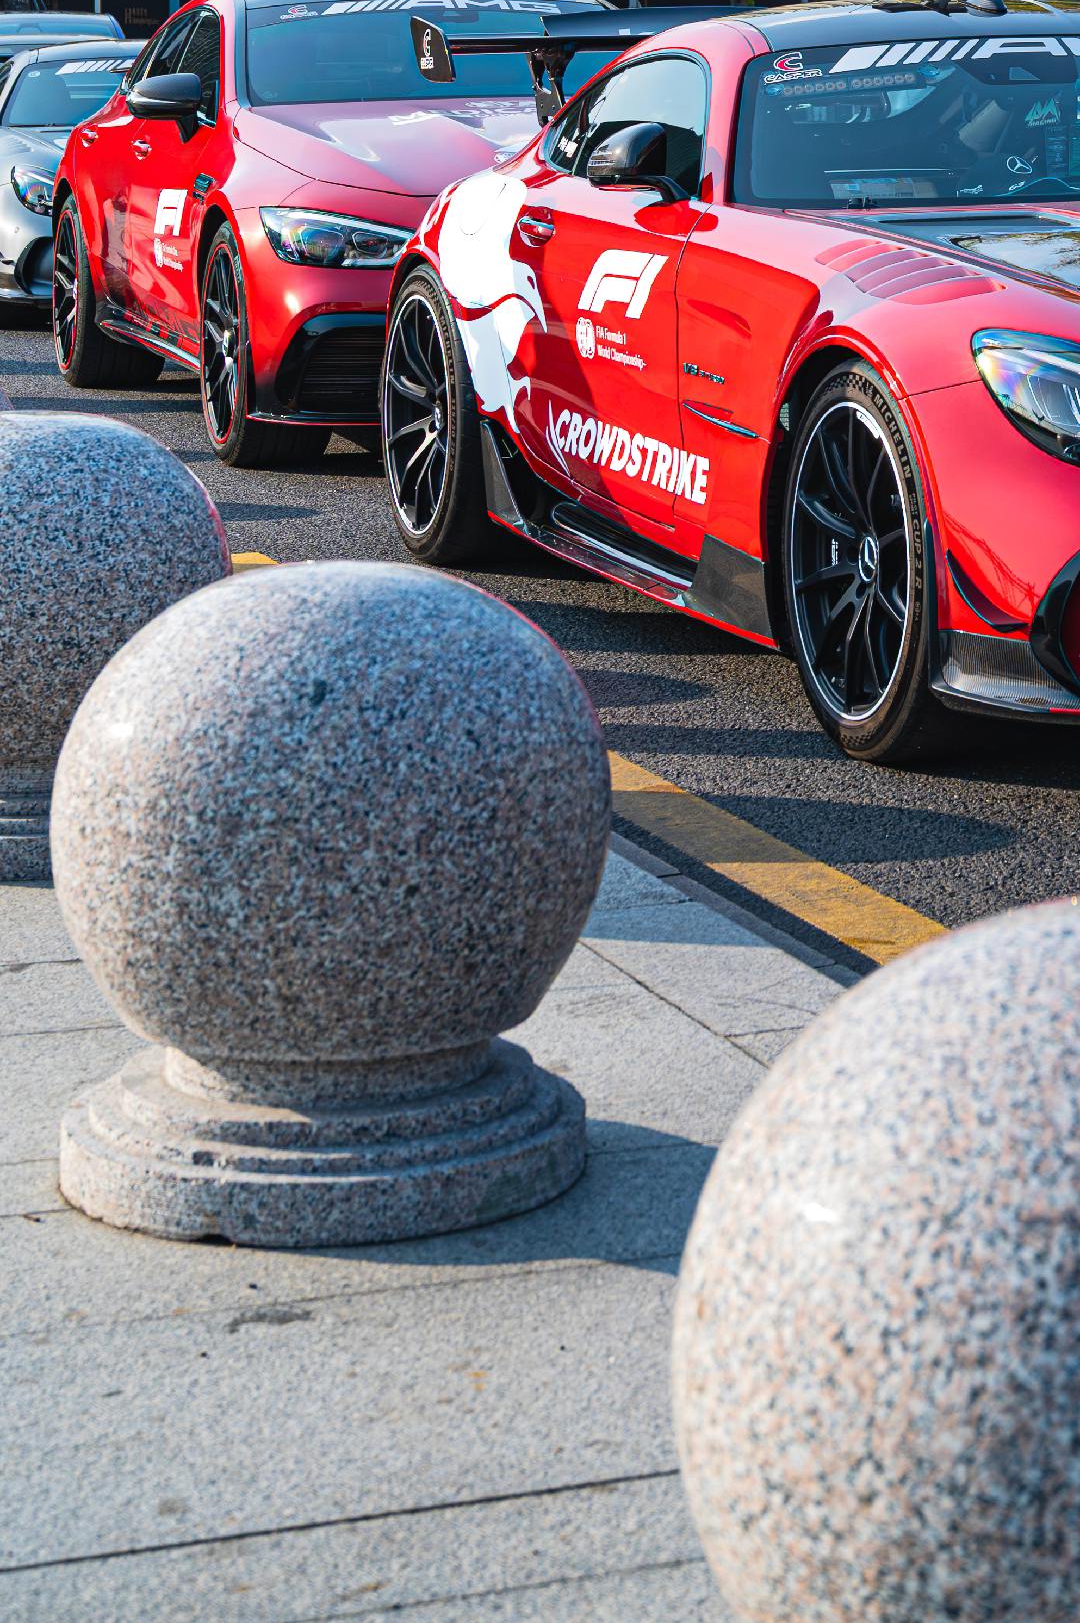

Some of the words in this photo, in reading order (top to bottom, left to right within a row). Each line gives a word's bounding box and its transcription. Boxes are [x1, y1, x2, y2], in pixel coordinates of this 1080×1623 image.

[764, 69, 822, 84] CASPER
[596, 344, 611, 360] World
[611, 347, 644, 371] Championship
[873, 393, 912, 478] MICHELIN
[554, 408, 711, 505] CROWDSTRIKE
[913, 518, 922, 555] CUP
